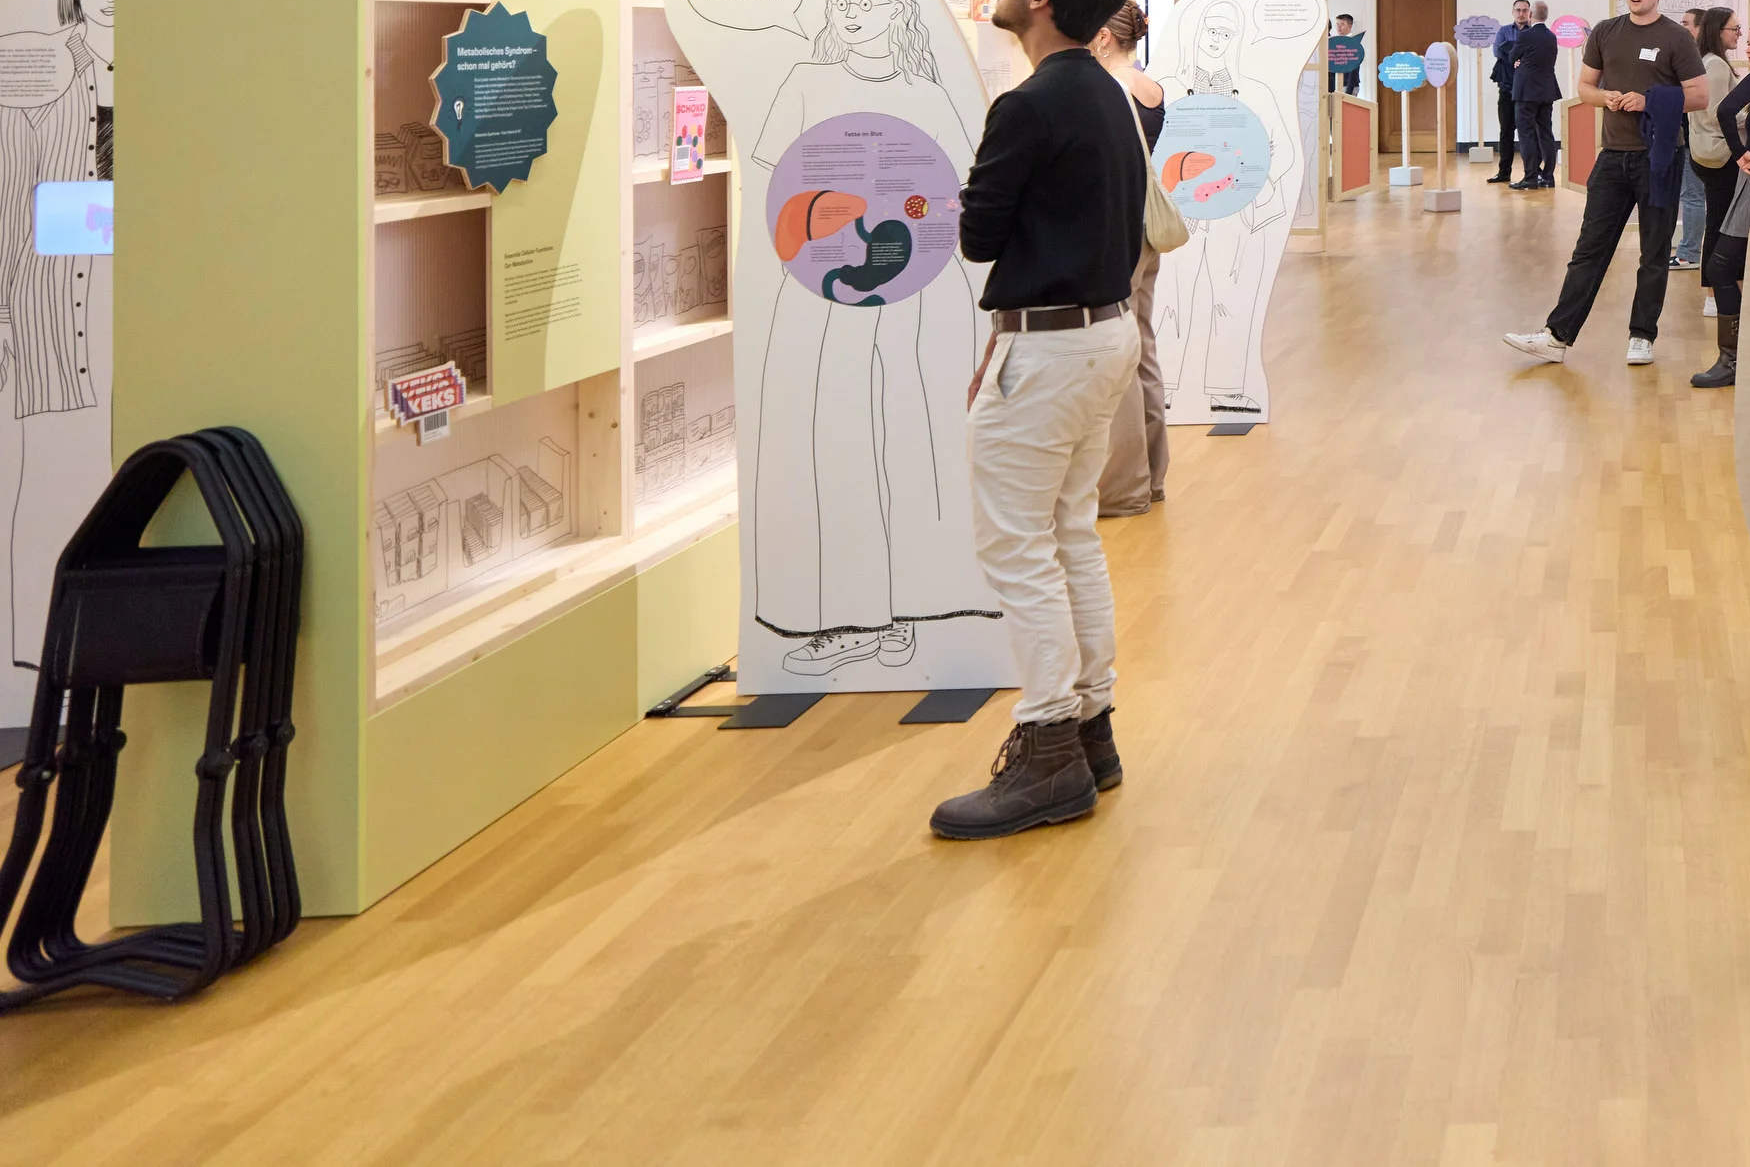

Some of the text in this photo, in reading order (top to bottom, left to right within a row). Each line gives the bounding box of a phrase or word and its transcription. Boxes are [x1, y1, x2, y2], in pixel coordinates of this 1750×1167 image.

[457, 47, 505, 56] Metabolisches
[505, 46, 533, 57] Syndrom
[457, 60, 516, 71] schon mal gehört?
[676, 104, 705, 113] SCHOKO
[407, 387, 455, 414] KEKS
